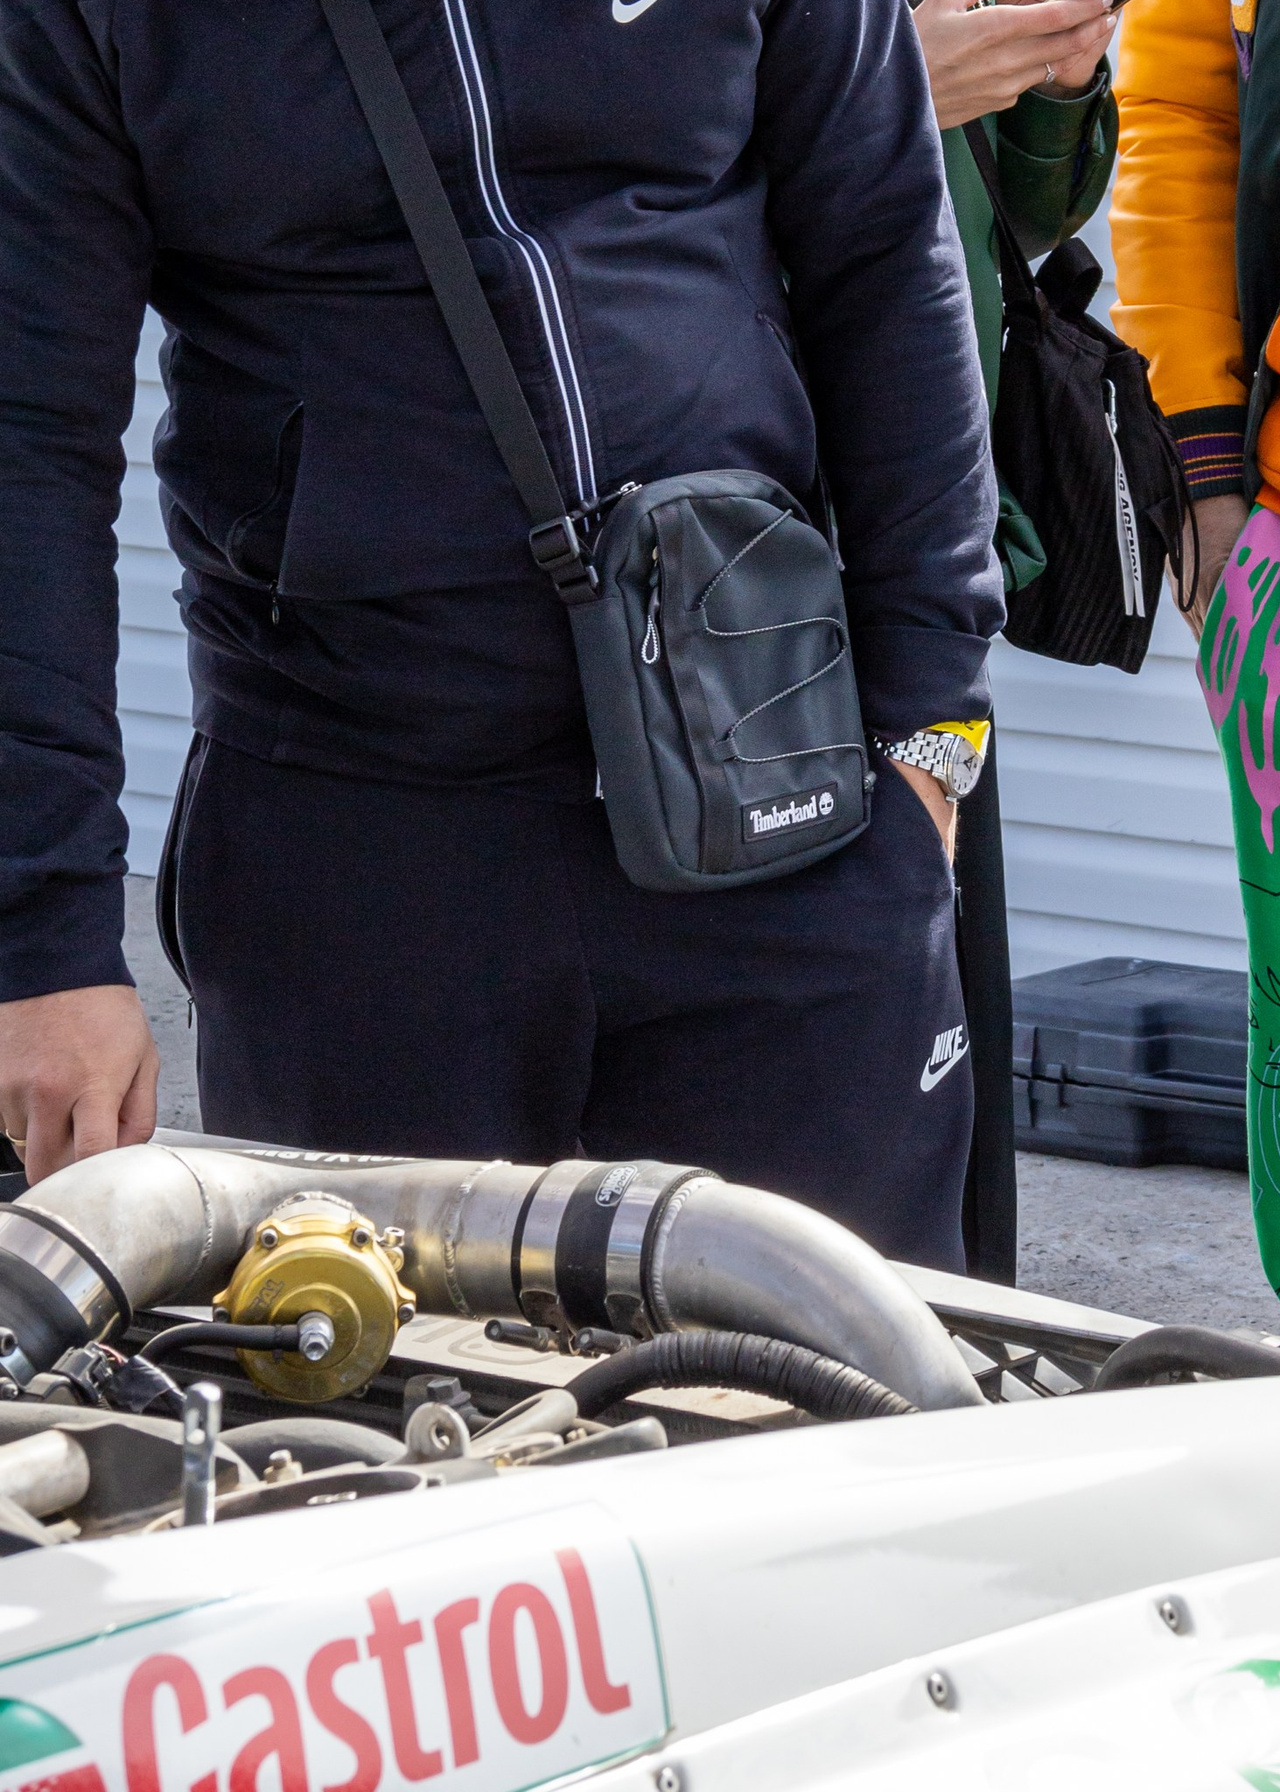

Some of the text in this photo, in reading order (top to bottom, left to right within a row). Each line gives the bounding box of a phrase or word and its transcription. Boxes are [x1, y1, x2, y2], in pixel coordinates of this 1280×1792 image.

[749, 794, 818, 834] Timberland
[929, 1024, 963, 1067] NIKE
[121, 1546, 632, 1792] Castrol
